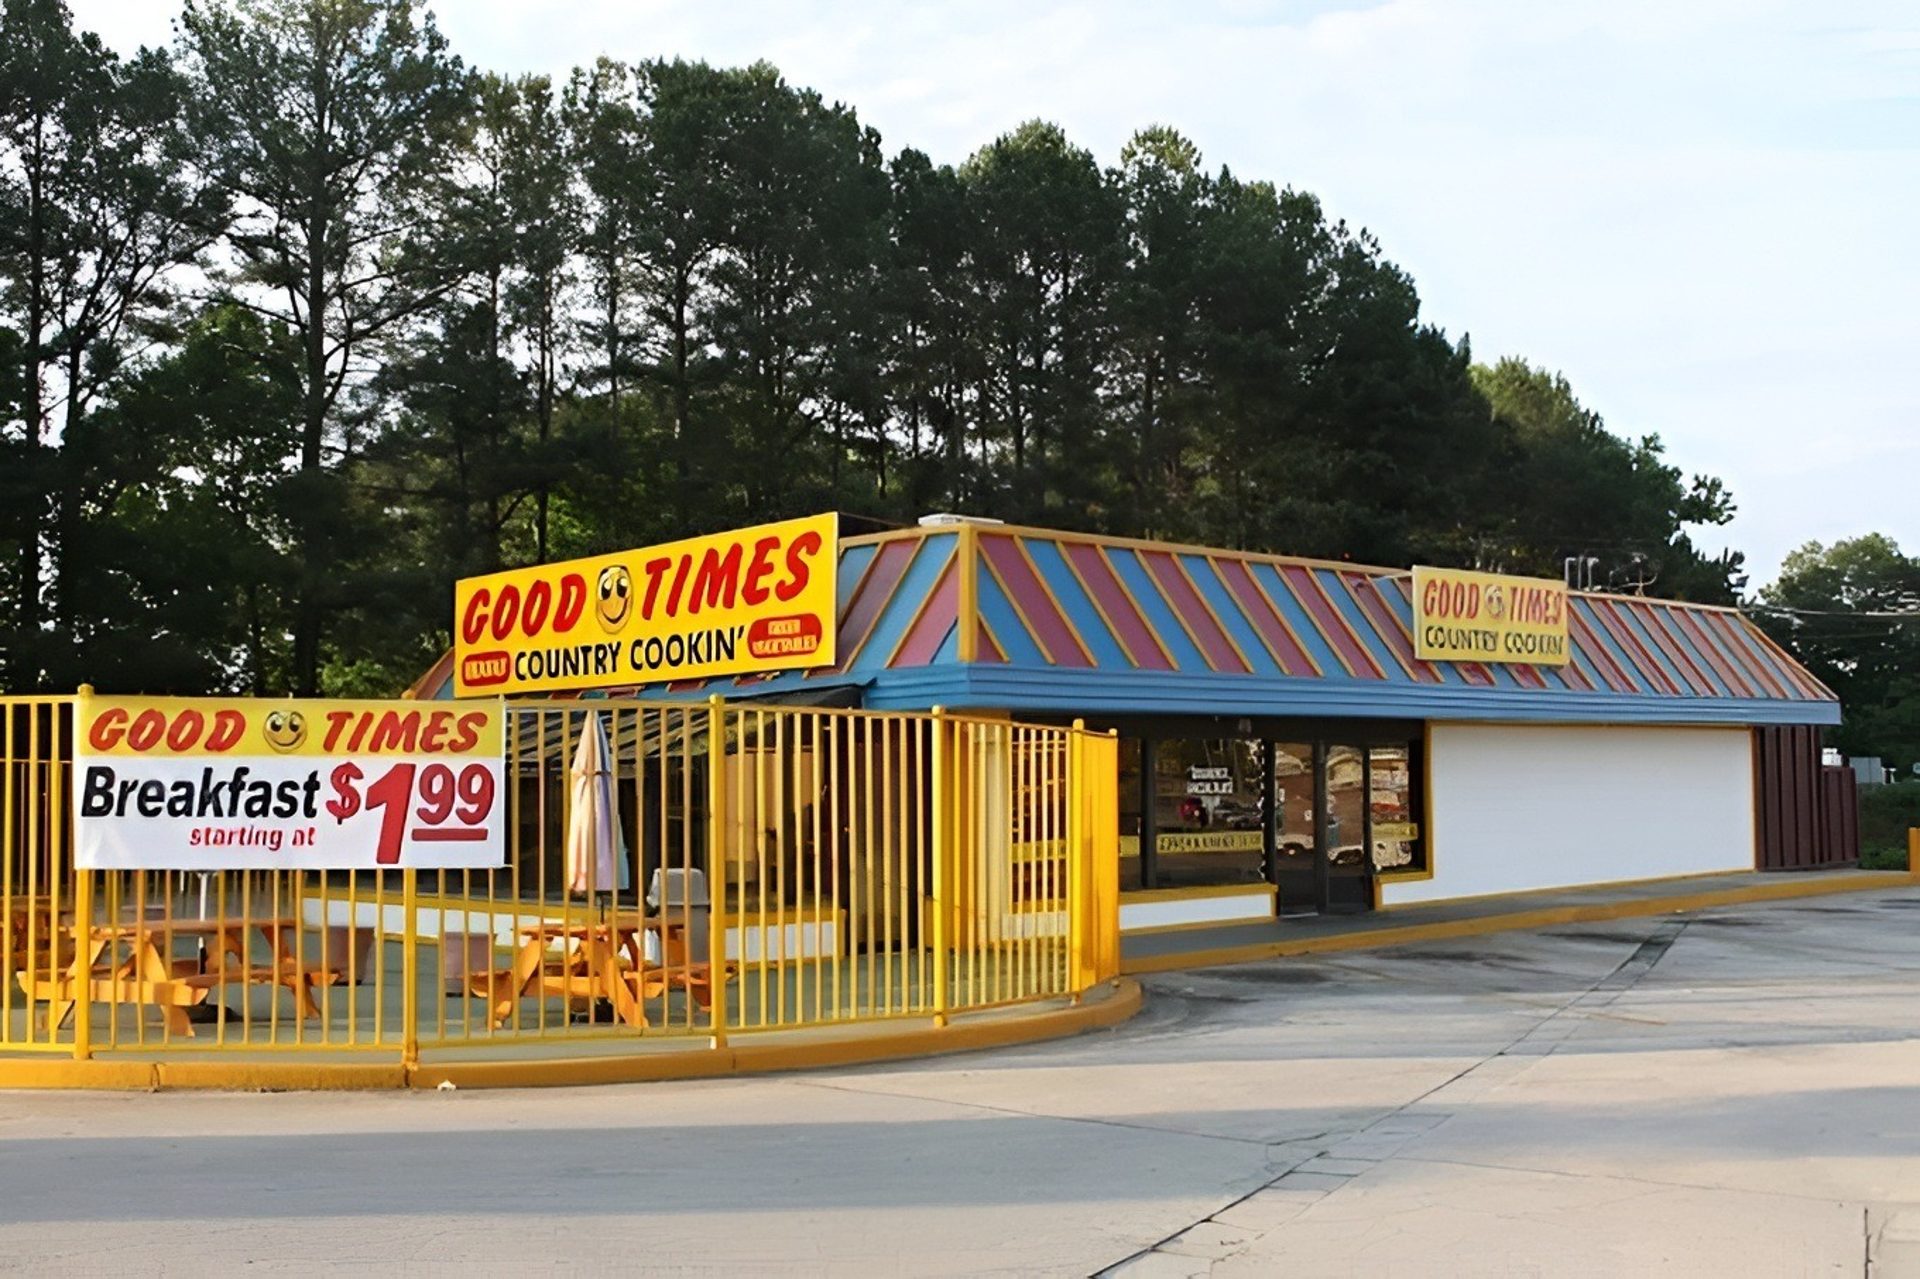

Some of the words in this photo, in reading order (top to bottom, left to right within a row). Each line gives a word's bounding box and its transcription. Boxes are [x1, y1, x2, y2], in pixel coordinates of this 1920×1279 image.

[462, 573, 587, 645] GOOD
[641, 530, 822, 620] TIMES
[1423, 578, 1480, 620] GOOD
[1510, 585, 1563, 625] TIMES
[1425, 625, 1499, 652] COUNTRY
[514, 641, 622, 682] COUNTRY
[89, 708, 246, 752] GOOD
[322, 711, 489, 753] TIMES
[81, 766, 321, 818] Breakfast
[189, 825, 283, 851] starting
[292, 826, 316, 846] at
